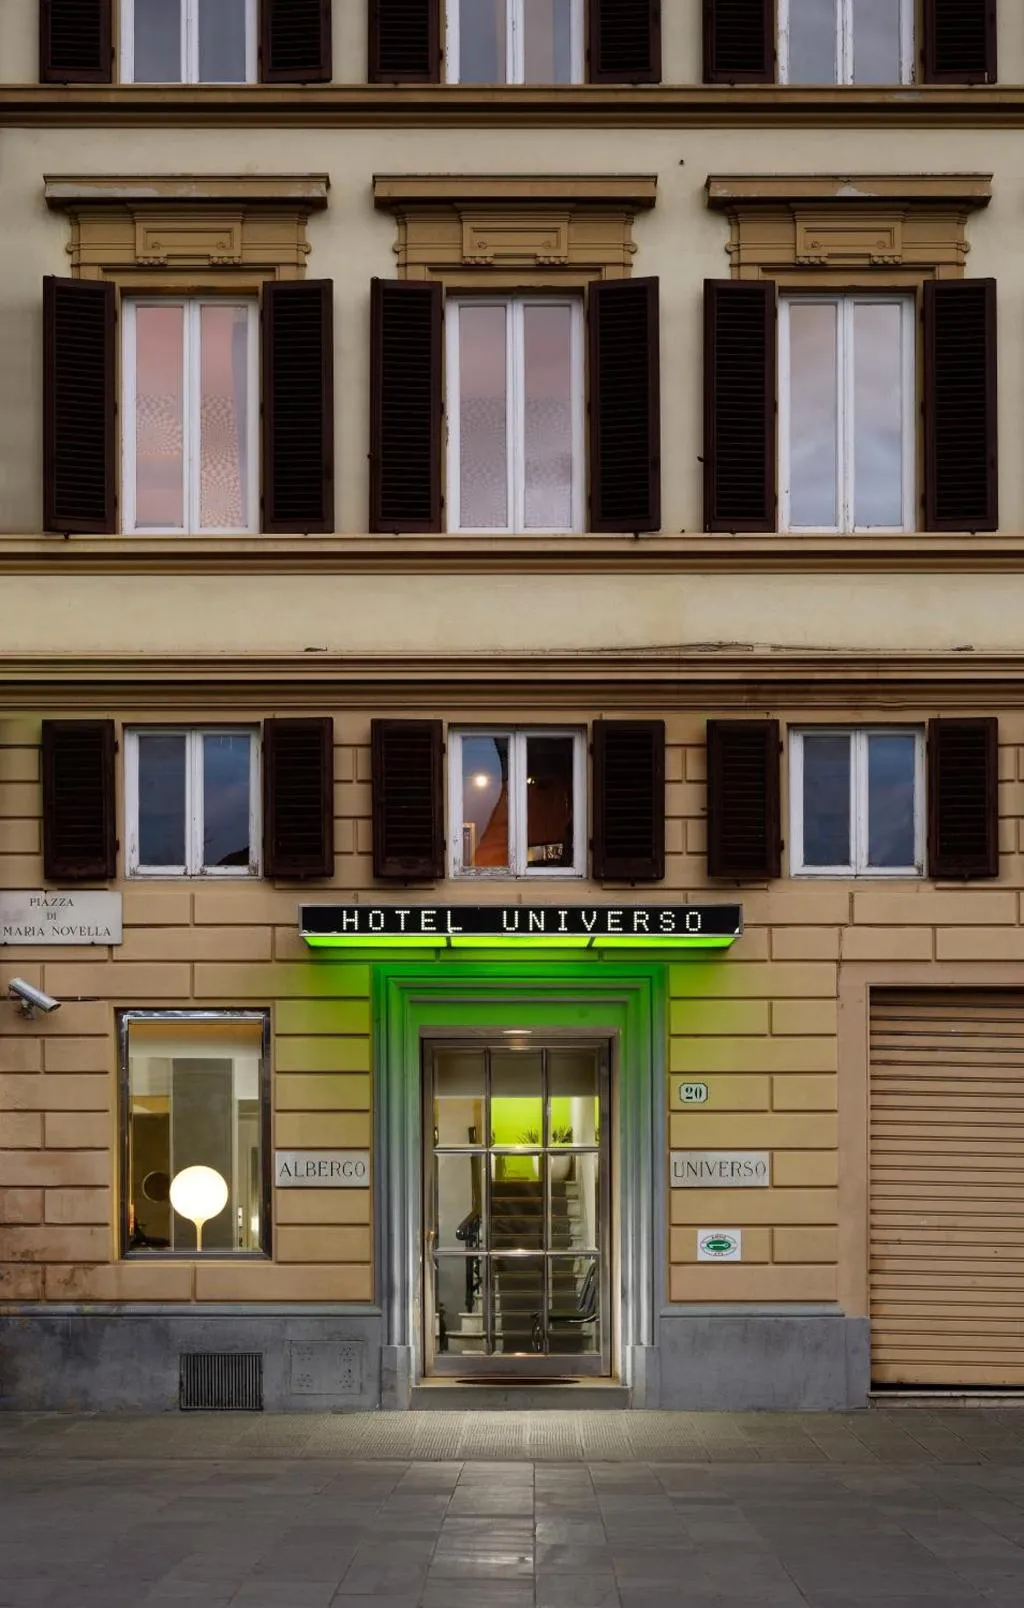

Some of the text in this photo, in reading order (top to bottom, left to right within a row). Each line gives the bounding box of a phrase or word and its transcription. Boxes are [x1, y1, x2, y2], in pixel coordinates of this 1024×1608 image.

[30, 898, 74, 907] PIAZZA
[47, 912, 56, 920] DI
[342, 910, 701, 932] HOTEL UNIVERSO
[3, 926, 111, 936] MARIA NOVELLA
[685, 1086, 702, 1100] 20
[280, 1161, 365, 1177] ALBERGO
[673, 1160, 767, 1178] UNIVERSO
